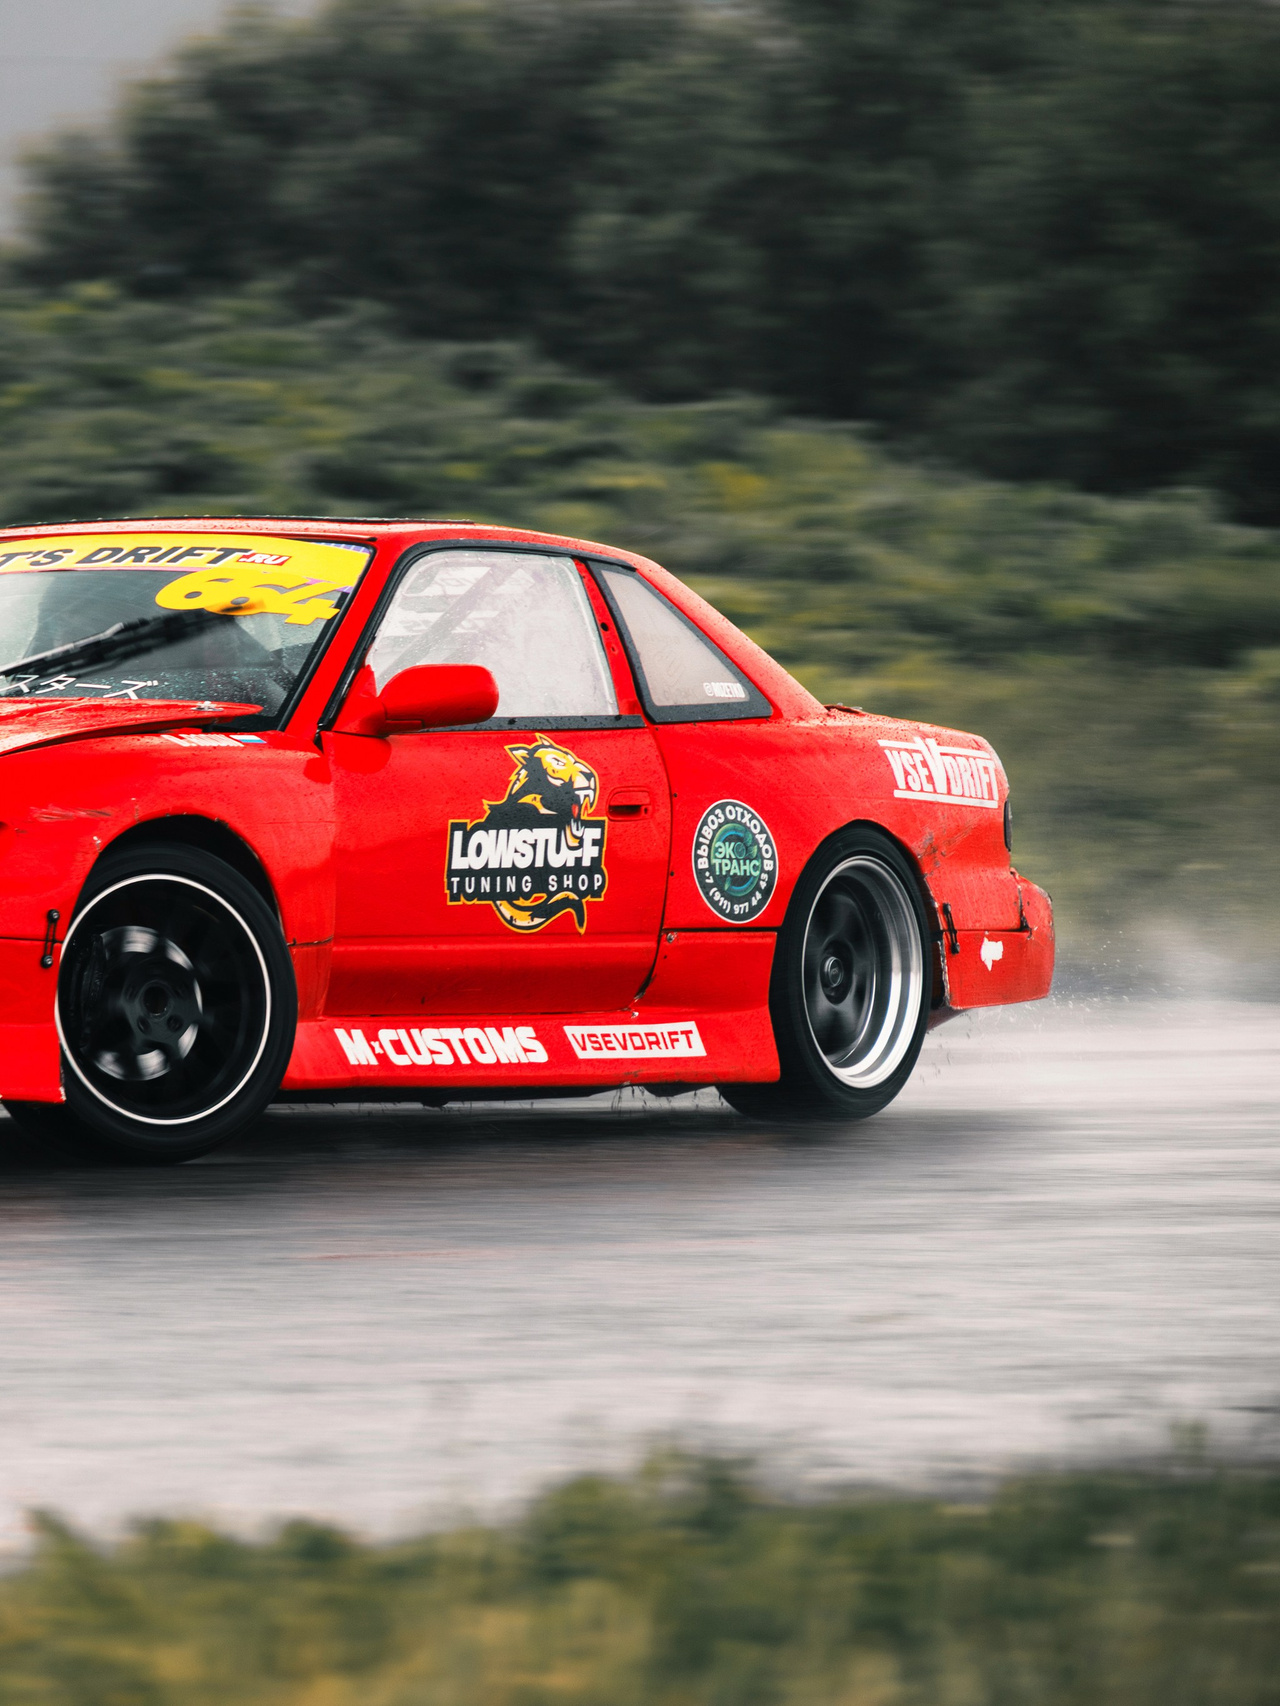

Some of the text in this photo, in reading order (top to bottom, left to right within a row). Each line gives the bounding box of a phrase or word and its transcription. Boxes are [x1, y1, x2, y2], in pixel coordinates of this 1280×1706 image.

[75, 547, 252, 567] DRIFT
[155, 567, 340, 626] 664
[697, 805, 774, 871] ВЫВОЗ ОТХОДОВ
[451, 828, 601, 870] LOWSTUFF
[713, 858, 760, 877] ТРАНС
[451, 874, 603, 893] TUNING SHOP
[733, 902, 749, 914] 977
[573, 1029, 694, 1052] VSEVDRIFT
